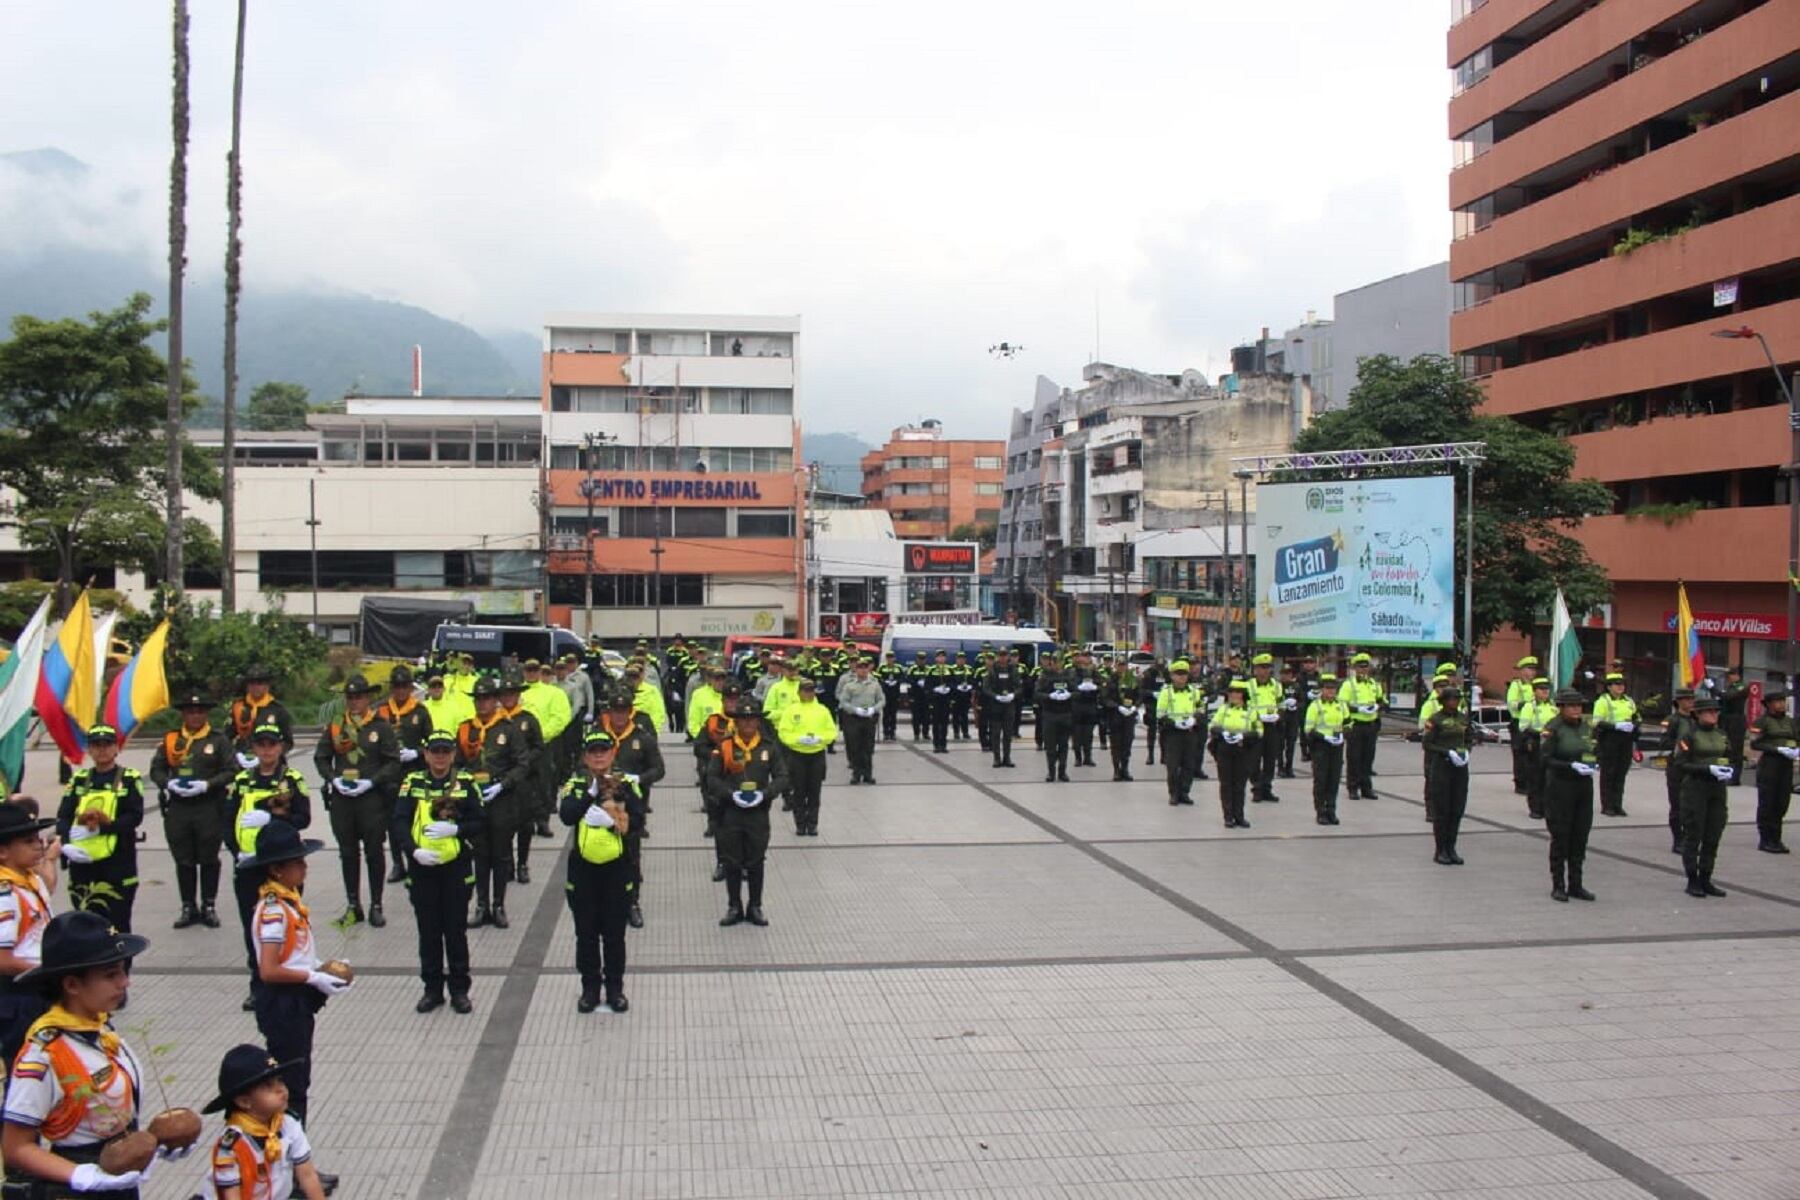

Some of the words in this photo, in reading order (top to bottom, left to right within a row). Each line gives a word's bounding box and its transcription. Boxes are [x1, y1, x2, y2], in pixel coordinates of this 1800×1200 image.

[651, 479, 762, 500] EMPRESARIAL
[1285, 547, 1326, 579] Gran
[1278, 574, 1344, 604] Lanzamiento
[1362, 585, 1372, 595] es
[1374, 581, 1412, 596] Colombia
[1371, 612, 1404, 627] Sábado
[1692, 619, 1721, 632] anco
[1722, 618, 1739, 633] AV
[1740, 619, 1773, 634] Villas
